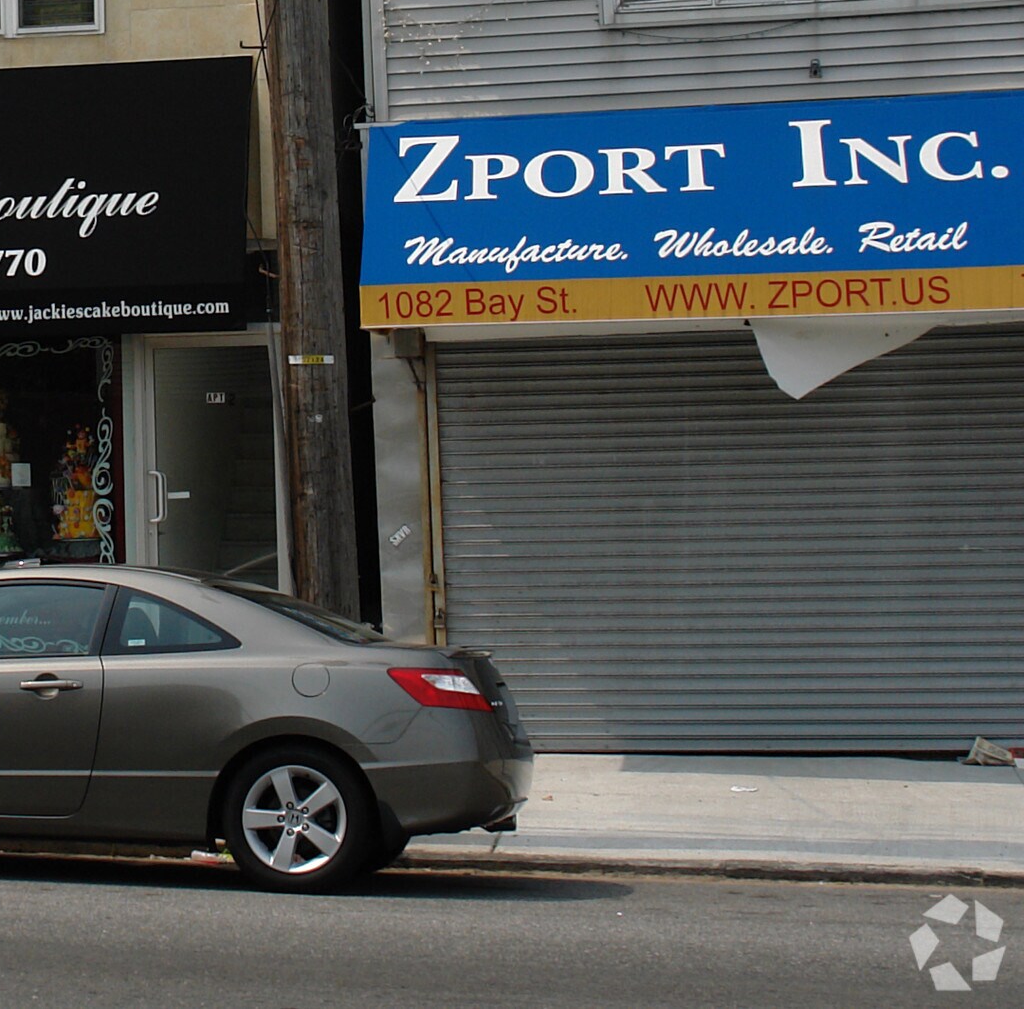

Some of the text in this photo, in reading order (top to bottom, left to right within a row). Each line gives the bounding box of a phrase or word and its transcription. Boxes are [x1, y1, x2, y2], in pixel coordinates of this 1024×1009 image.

[393, 119, 1009, 203] ZPORT INC.
[404, 221, 968, 274] Manufacture. Wholesale. Retail
[378, 286, 577, 322] 1082 Bay St.
[207, 392, 225, 403] APT
